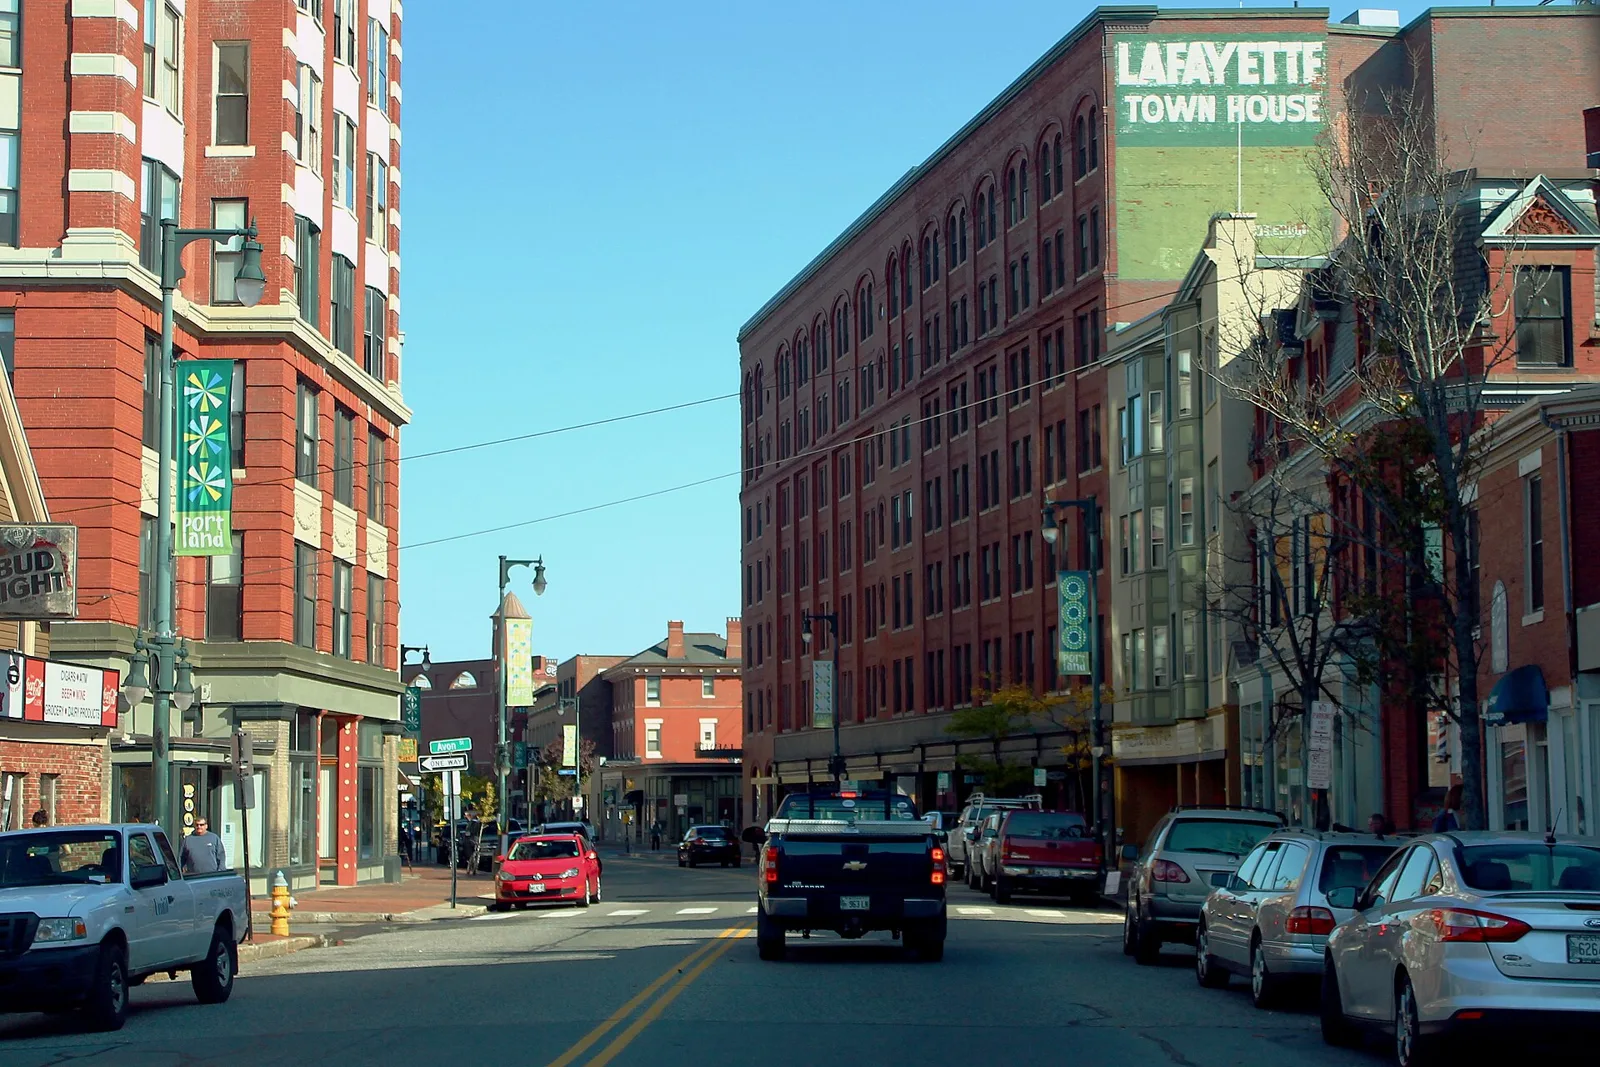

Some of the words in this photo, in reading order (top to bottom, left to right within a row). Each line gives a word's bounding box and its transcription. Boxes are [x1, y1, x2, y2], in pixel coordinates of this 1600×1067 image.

[1117, 41, 1323, 85] LAFAYETTE
[1124, 94, 1216, 123] TOWN
[1227, 94, 1321, 123] HOUSE
[182, 515, 224, 532] port
[182, 530, 224, 548] land
[0, 551, 55, 579] BUD
[0, 572, 65, 602] IGHT
[61, 688, 72, 699] BEER
[76, 690, 86, 700] WINE
[45, 704, 64, 716] GROCERY
[68, 706, 79, 718] DAIRY
[80, 707, 100, 719] PRODUCTS
[437, 742, 457, 751] Avon
